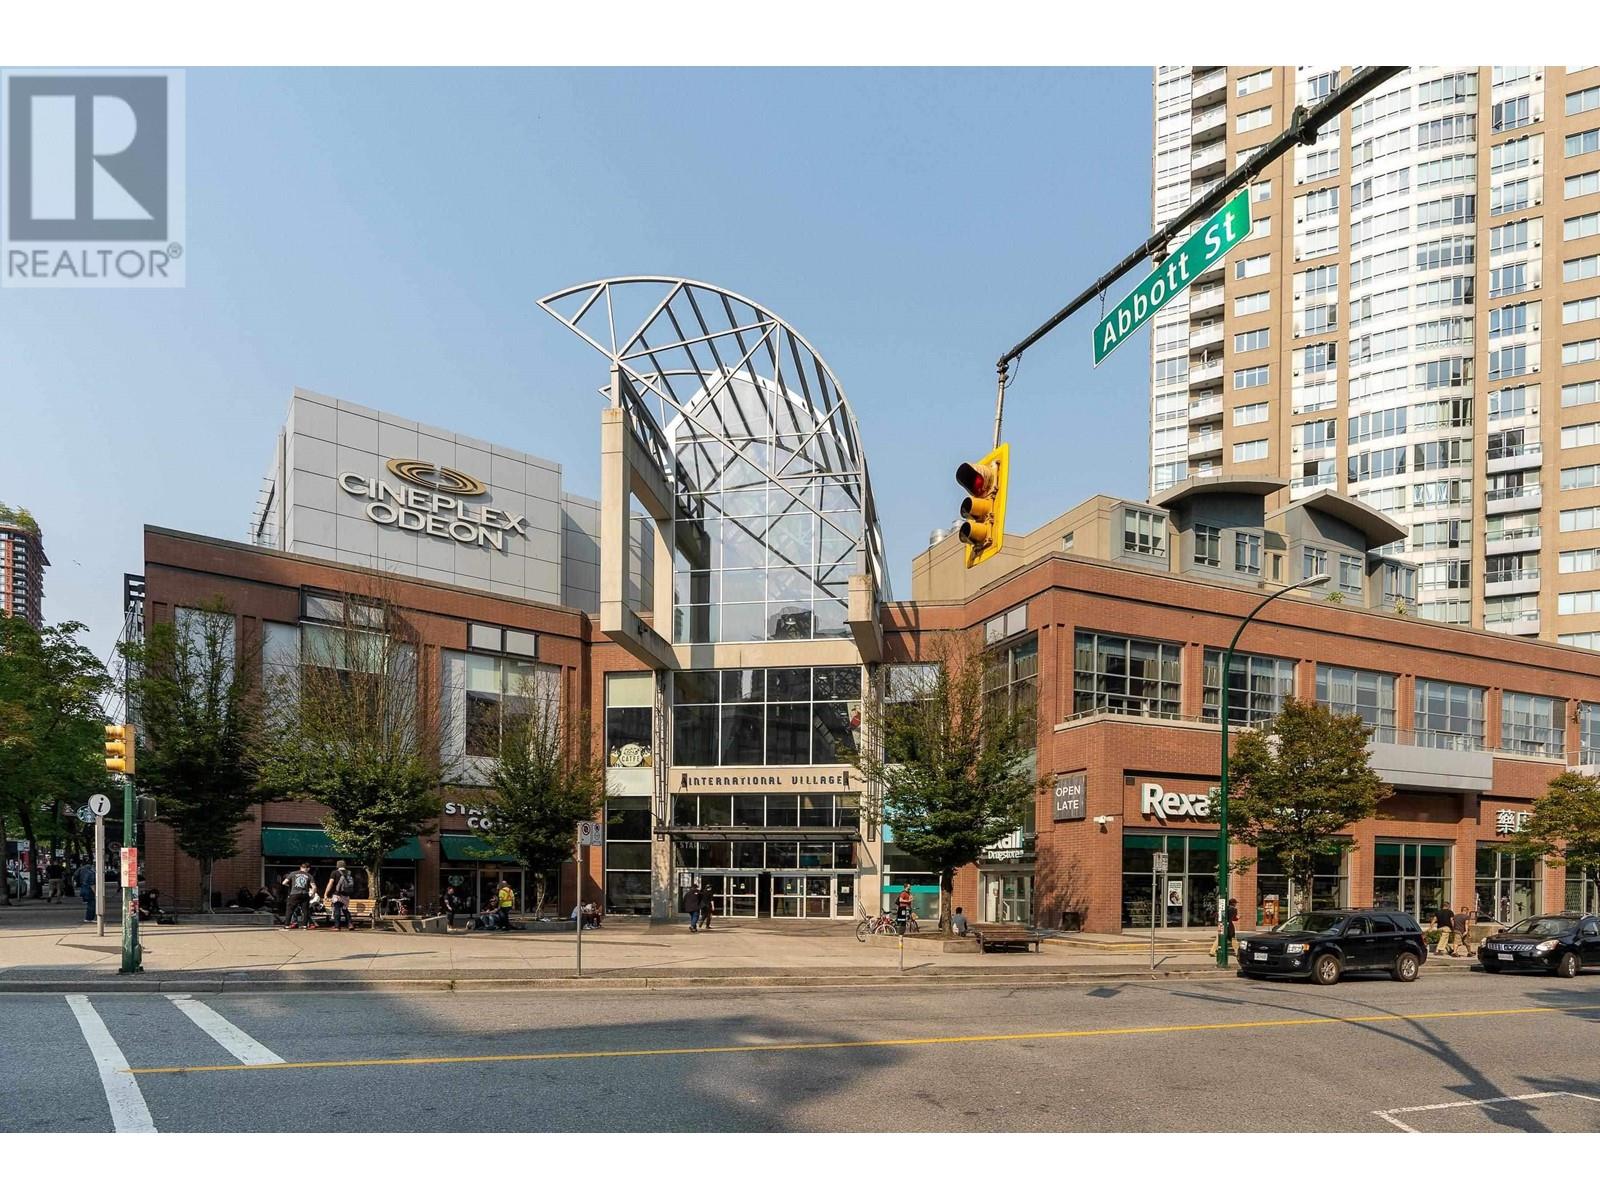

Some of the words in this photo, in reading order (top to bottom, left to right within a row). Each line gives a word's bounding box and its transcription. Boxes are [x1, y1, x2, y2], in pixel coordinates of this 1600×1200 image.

[1102, 251, 1190, 353] Abbott
[1204, 210, 1237, 261] St
[338, 471, 526, 535] CINEPLEX
[366, 502, 503, 550] ODEON
[688, 776, 783, 786] INTERNATIONAL
[791, 775, 843, 785] VILLAGE
[1055, 785, 1081, 797] OPEN
[1056, 799, 1080, 811] LATE
[1141, 783, 1222, 819] Rexa
[987, 849, 1023, 862] Drugstore
